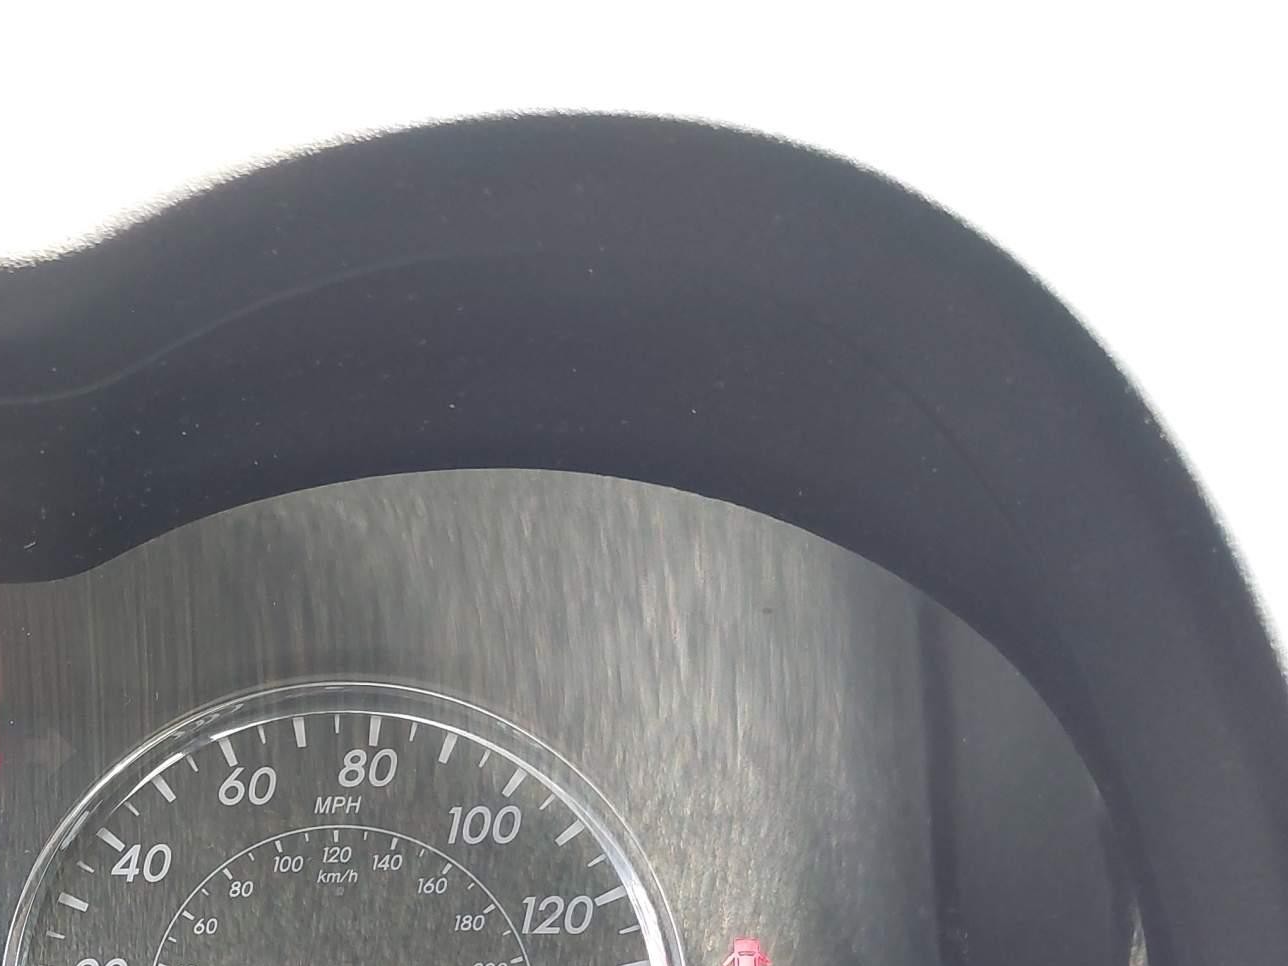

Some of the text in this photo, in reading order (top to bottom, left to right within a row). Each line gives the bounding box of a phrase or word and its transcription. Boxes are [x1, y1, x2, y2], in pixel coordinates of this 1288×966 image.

[338, 749, 398, 787] 80
[218, 767, 277, 806] 60
[314, 797, 361, 815] MPH
[447, 807, 521, 844] 100
[111, 844, 172, 883] 40
[273, 855, 304, 873] 100
[322, 847, 352, 864] 120
[372, 853, 403, 872] 140
[316, 868, 359, 885] km/h
[229, 880, 253, 898] 80
[416, 877, 448, 895] 160
[454, 914, 485, 932] 180
[521, 897, 593, 934] 120
[194, 916, 218, 934] 60
